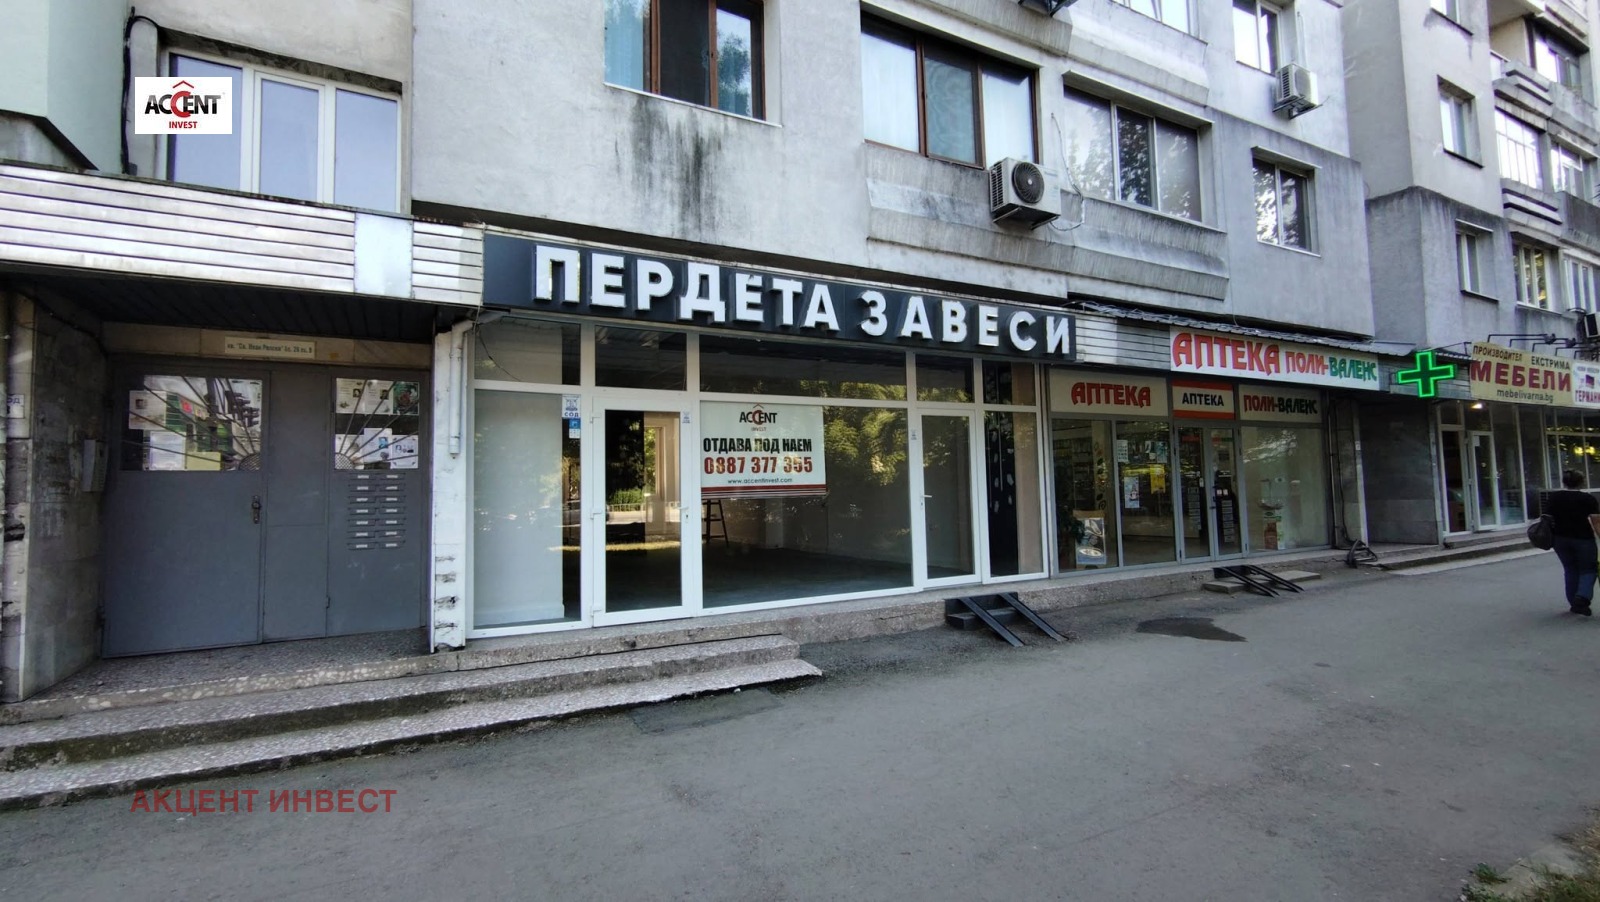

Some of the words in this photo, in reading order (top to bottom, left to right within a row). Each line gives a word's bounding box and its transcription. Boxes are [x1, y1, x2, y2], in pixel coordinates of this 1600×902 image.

[535, 244, 841, 332] ПЕРДЕТА
[860, 289, 1070, 354] ЗАВЕСИ
[1172, 332, 1280, 376] АПТЕКА
[1285, 351, 1378, 382] ПОЛИ-ВАЛЕНС
[1531, 356, 1571, 370] ЕКСТРИМА
[1470, 359, 1571, 393] МЕБЕЛИ
[1071, 382, 1151, 408] АПТЕКА
[1182, 392, 1225, 407] АПТЕКА
[1496, 388, 1554, 403] mebelivarna.bg
[1243, 394, 1318, 415] ПОЛИ-ВАЛЕНС
[739, 409, 778, 426] ACCENT
[703, 438, 752, 454] ОТДАВА
[754, 438, 780, 454] ПОД
[782, 438, 813, 452] НАЕМ
[704, 457, 746, 474] 0887
[751, 457, 778, 474] 377
[783, 457, 813, 473] 355
